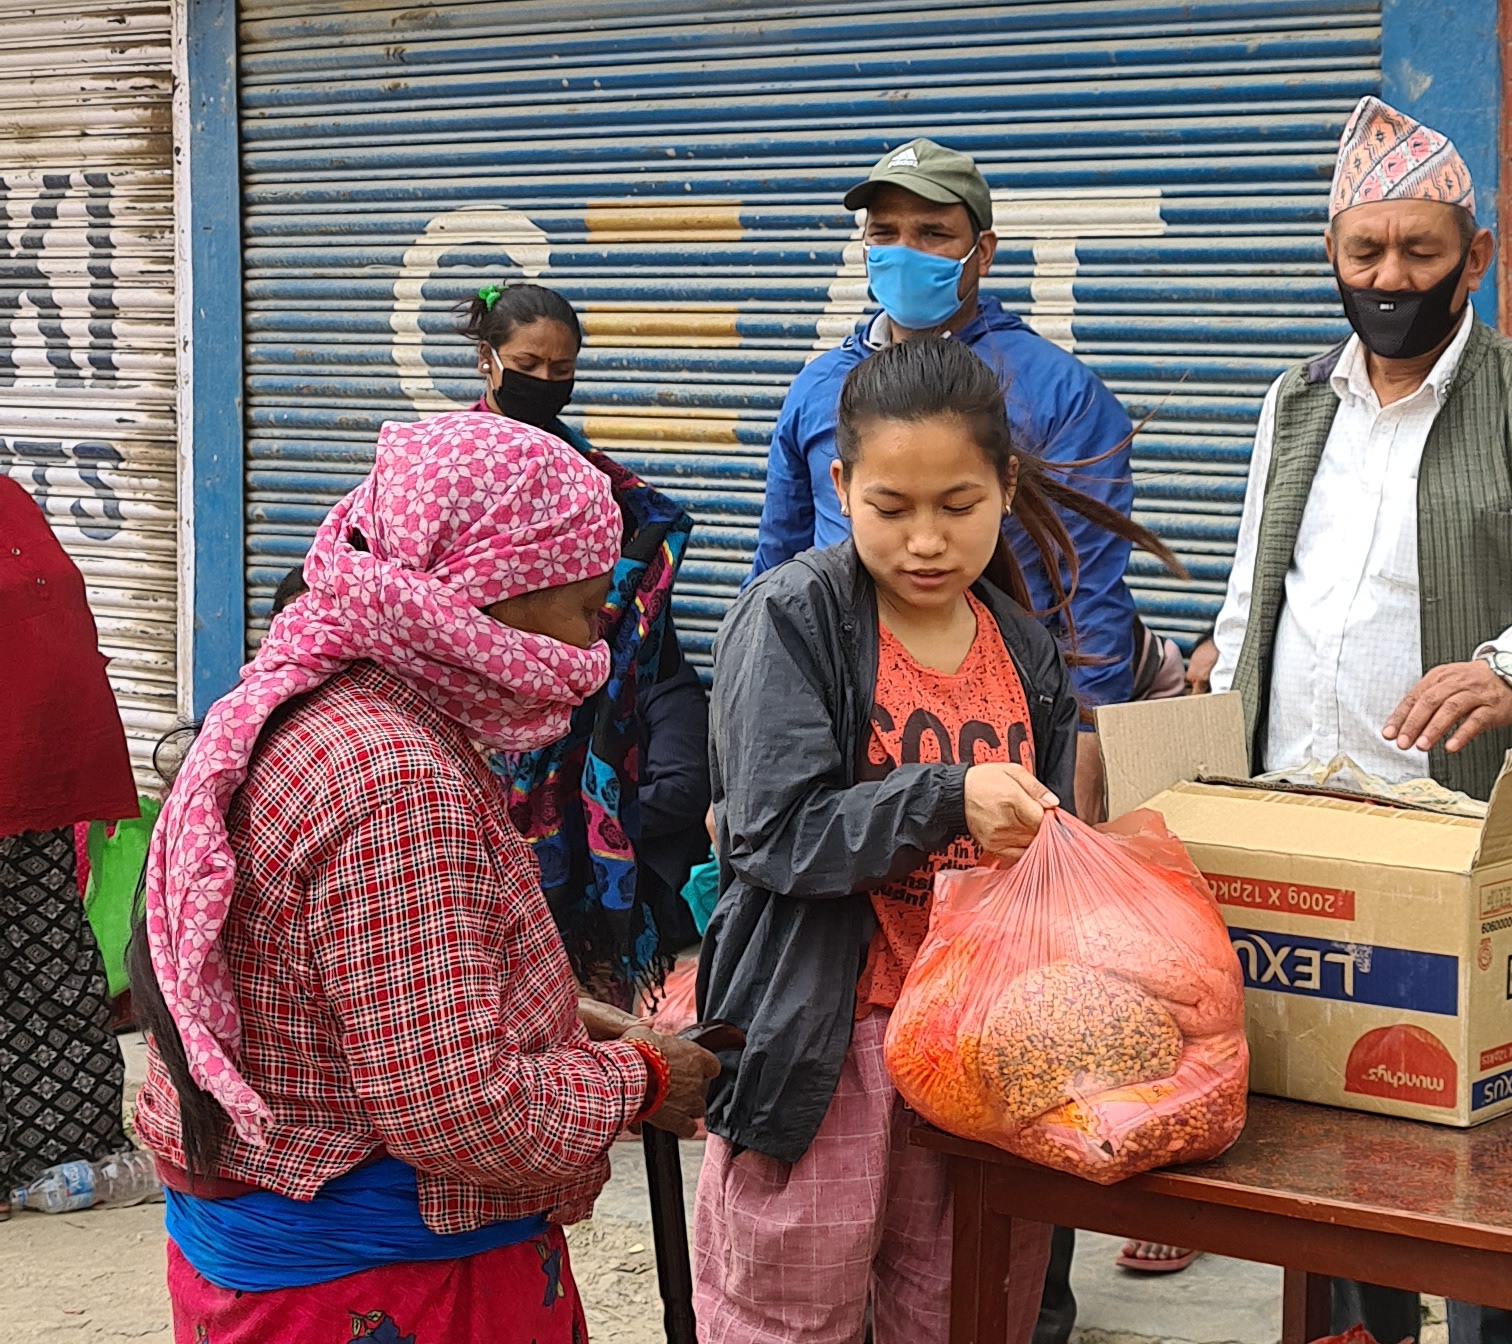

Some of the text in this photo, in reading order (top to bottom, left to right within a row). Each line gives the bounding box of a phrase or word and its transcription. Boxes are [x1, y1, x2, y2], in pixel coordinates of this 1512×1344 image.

[1211, 878, 1336, 913] 200g X 12pkt
[1232, 934, 1354, 997] LEXU
[1368, 1063, 1445, 1092] munchy's
